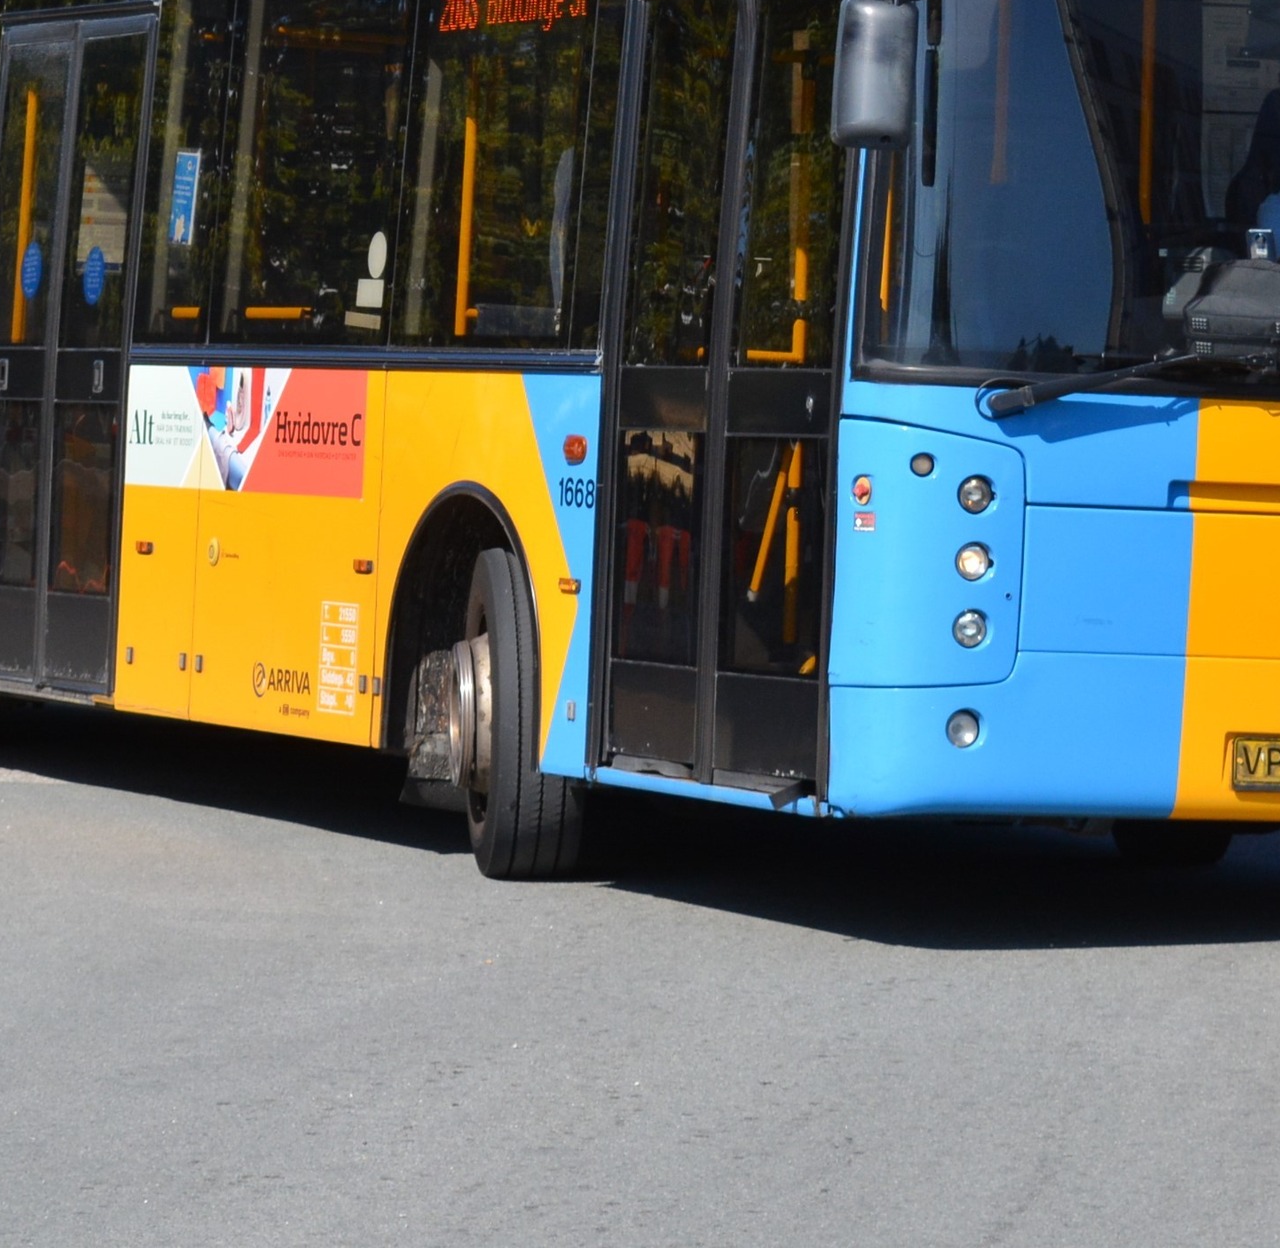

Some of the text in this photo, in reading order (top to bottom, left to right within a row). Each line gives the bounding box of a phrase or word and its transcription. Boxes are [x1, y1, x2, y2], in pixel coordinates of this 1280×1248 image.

[128, 409, 155, 445] Alt
[275, 411, 362, 447] Hvidovre C
[559, 477, 596, 509] 1668
[266, 667, 311, 696] ARRIVA
